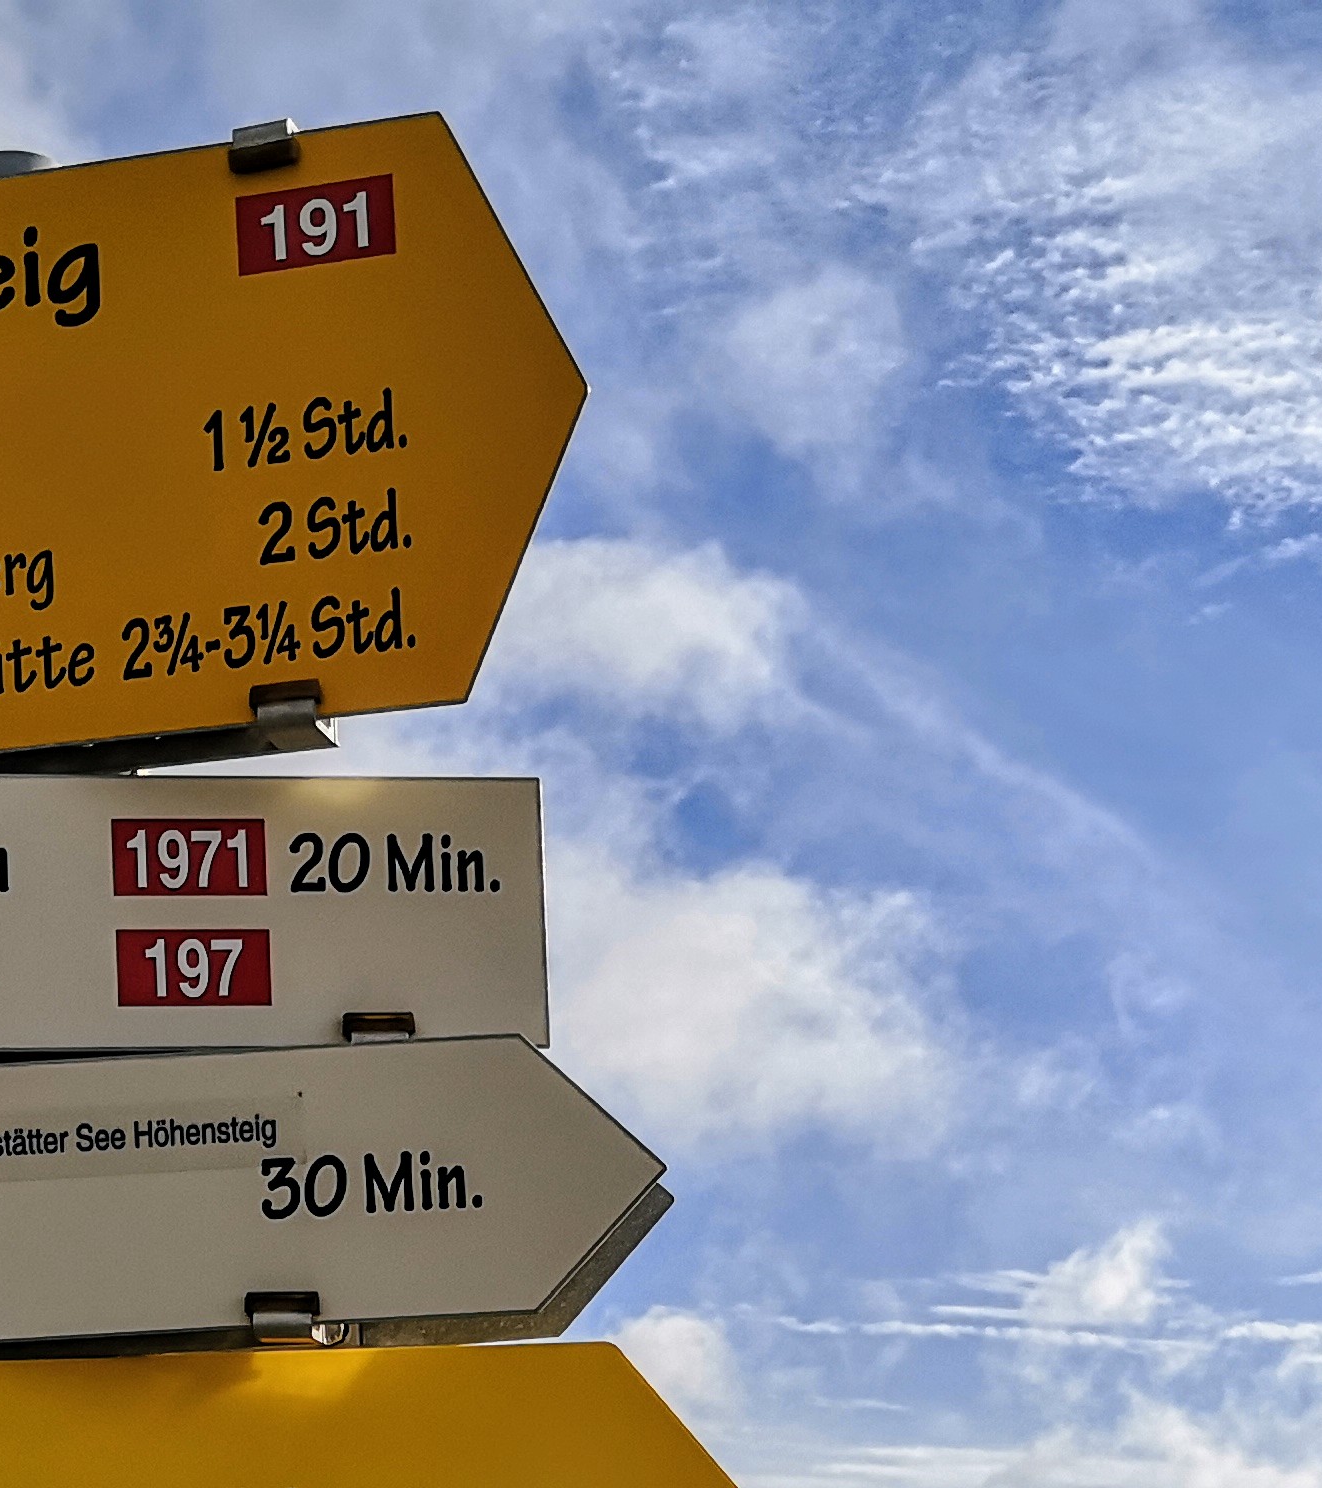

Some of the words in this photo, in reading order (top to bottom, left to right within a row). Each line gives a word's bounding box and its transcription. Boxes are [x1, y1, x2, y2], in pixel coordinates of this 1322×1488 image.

[260, 191, 369, 260] 191
[303, 388, 407, 459] Std.
[259, 502, 295, 565] 2
[307, 488, 411, 559] Std.
[311, 587, 415, 658] Std.
[127, 829, 248, 888] 1971
[289, 833, 370, 893] 20
[387, 833, 500, 892] Min.
[145, 939, 242, 997] 197
[76, 1123, 126, 1151] See
[134, 1114, 276, 1148] Höhensteig
[261, 1155, 347, 1219] 30
[364, 1151, 482, 1213] Min.
